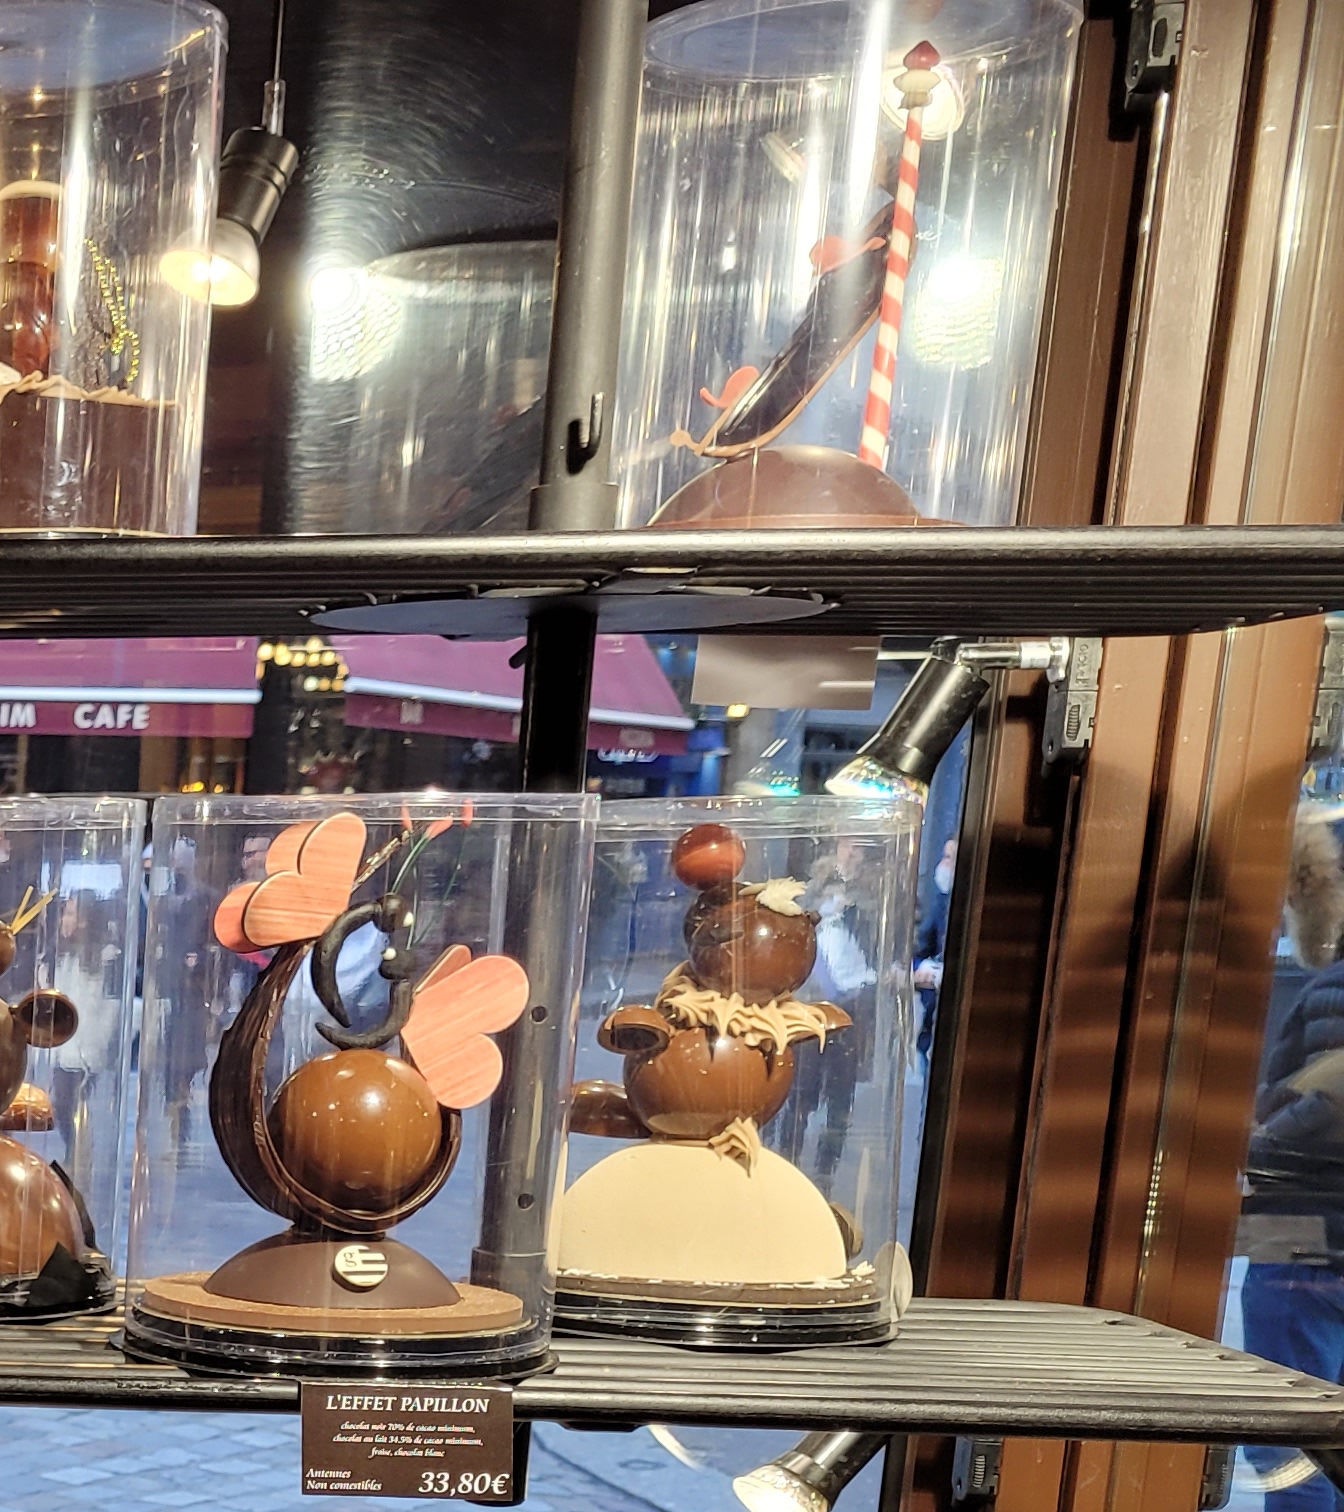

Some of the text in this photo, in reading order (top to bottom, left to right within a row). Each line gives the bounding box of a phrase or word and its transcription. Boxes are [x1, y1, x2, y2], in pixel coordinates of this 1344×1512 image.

[72, 703, 150, 730] CAFE
[343, 1252, 357, 1267] g
[325, 1395, 490, 1413] L'EFFET PAPILLON
[340, 1421, 370, 1430] chocolat
[387, 1423, 405, 1431] 70%
[406, 1423, 416, 1431] de
[332, 1434, 362, 1442] chocolat
[374, 1434, 387, 1443] lait
[413, 1436, 422, 1444] de
[423, 1437, 444, 1445] cacao
[394, 1447, 423, 1457] chocolat
[424, 1448, 445, 1457] blanc
[306, 1468, 351, 1479] Antennes
[306, 1479, 382, 1491] Non comestibles
[418, 1471, 510, 1496] 33,80€
